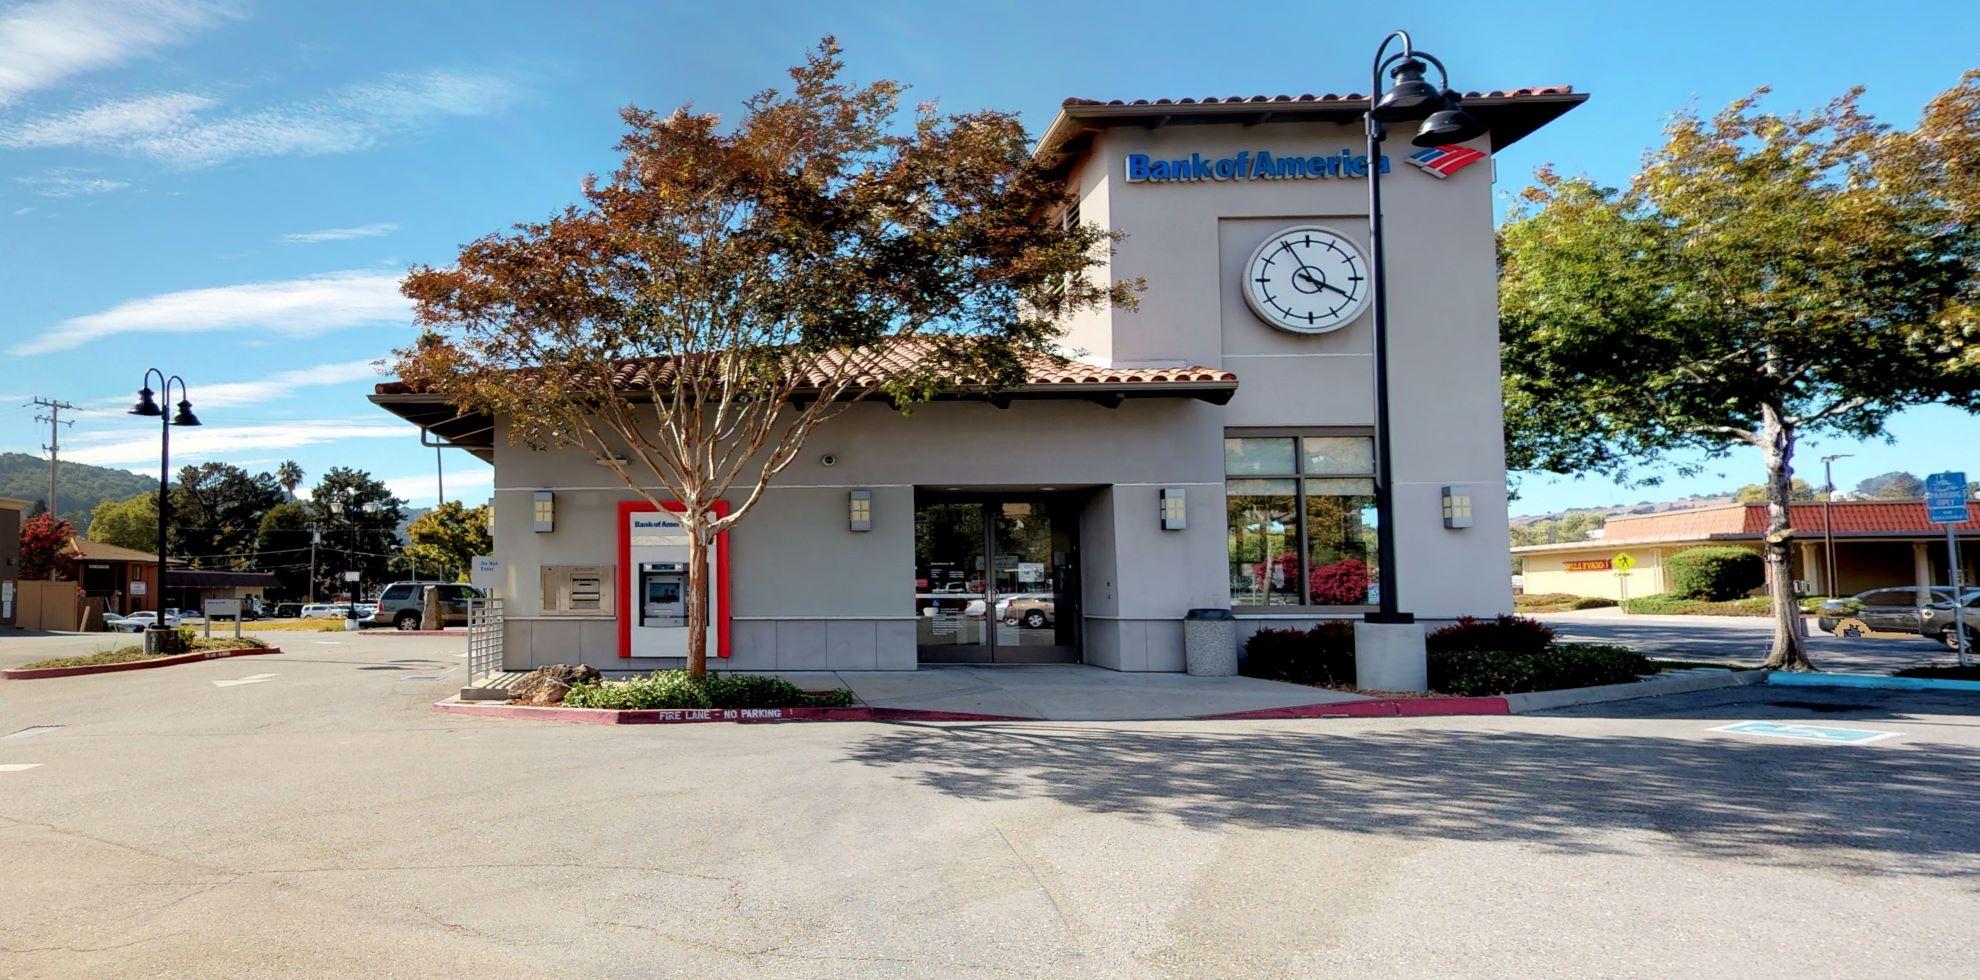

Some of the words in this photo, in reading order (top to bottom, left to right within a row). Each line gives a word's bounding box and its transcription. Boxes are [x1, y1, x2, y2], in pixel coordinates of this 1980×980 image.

[1127, 153, 1212, 182] Bank
[1213, 151, 1249, 181] of
[1252, 148, 1391, 180] America
[659, 711, 681, 720] FIRE
[685, 710, 711, 719] LANE
[723, 709, 737, 719] NO
[740, 708, 781, 719] PARKING
